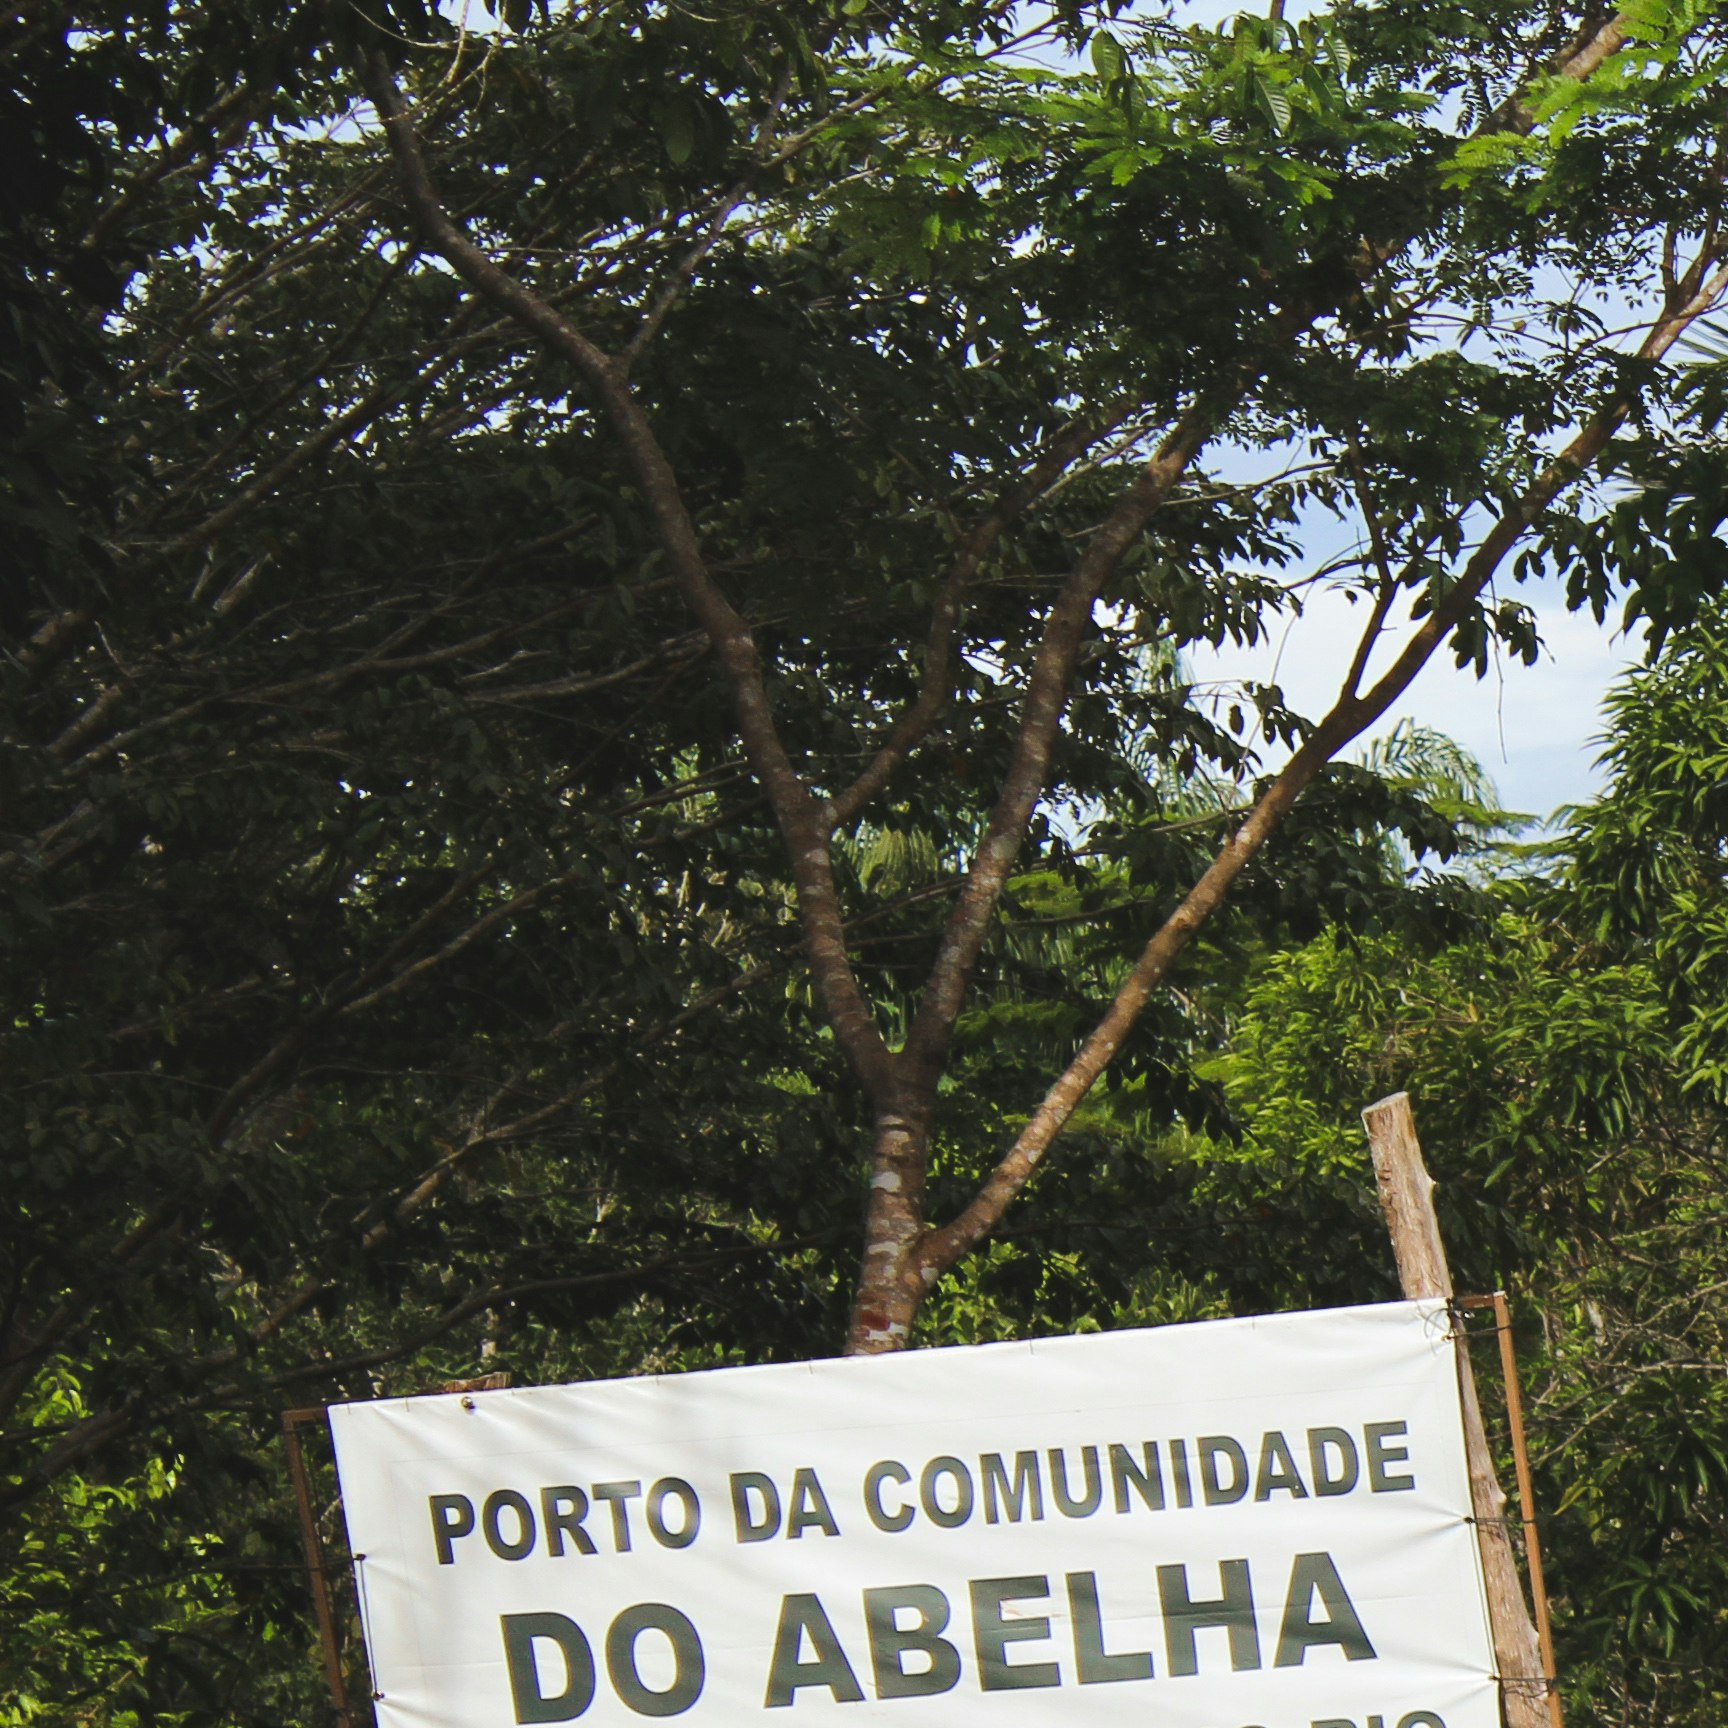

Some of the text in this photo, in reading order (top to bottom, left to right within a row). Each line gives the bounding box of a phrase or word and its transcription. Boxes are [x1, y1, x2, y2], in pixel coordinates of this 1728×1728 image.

[429, 1421, 1415, 1564] PORTO DA COMUNIDADE
[501, 1552, 1377, 1724] DO ABELHA
